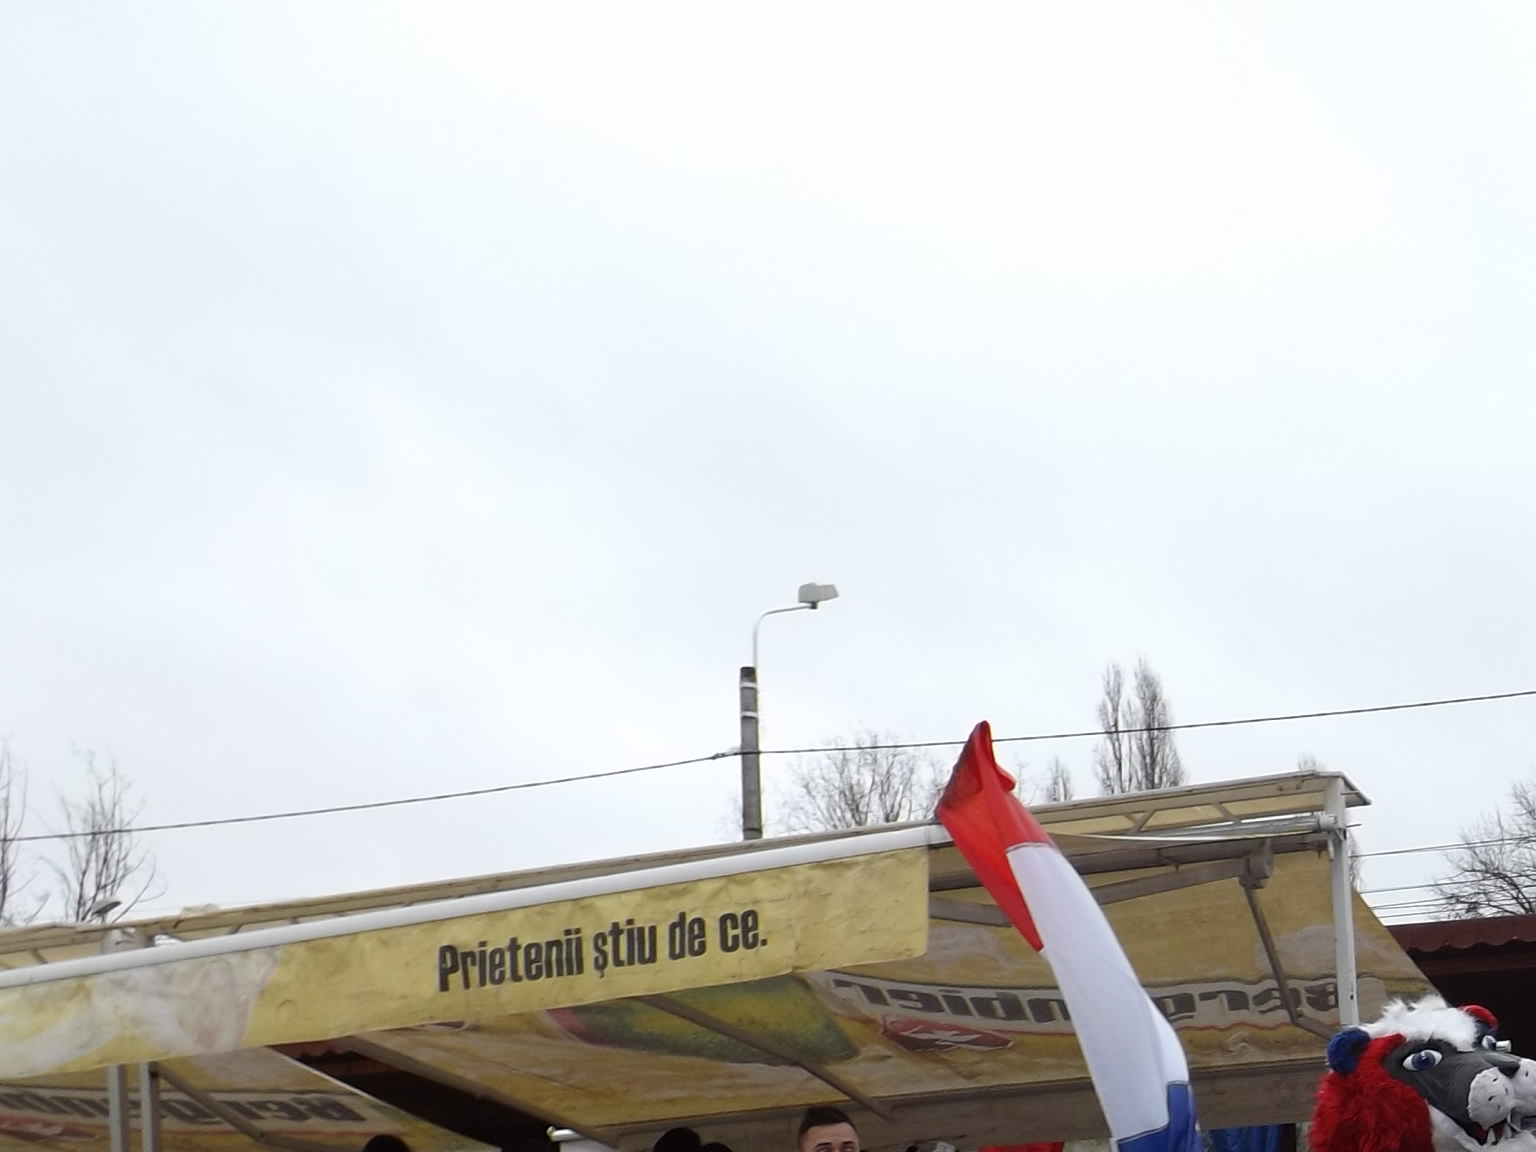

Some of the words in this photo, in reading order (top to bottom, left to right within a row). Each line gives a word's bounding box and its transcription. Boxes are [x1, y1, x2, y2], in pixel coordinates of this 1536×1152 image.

[438, 927, 584, 992] Prietenii
[668, 911, 707, 961] de
[718, 909, 768, 953] ce.
